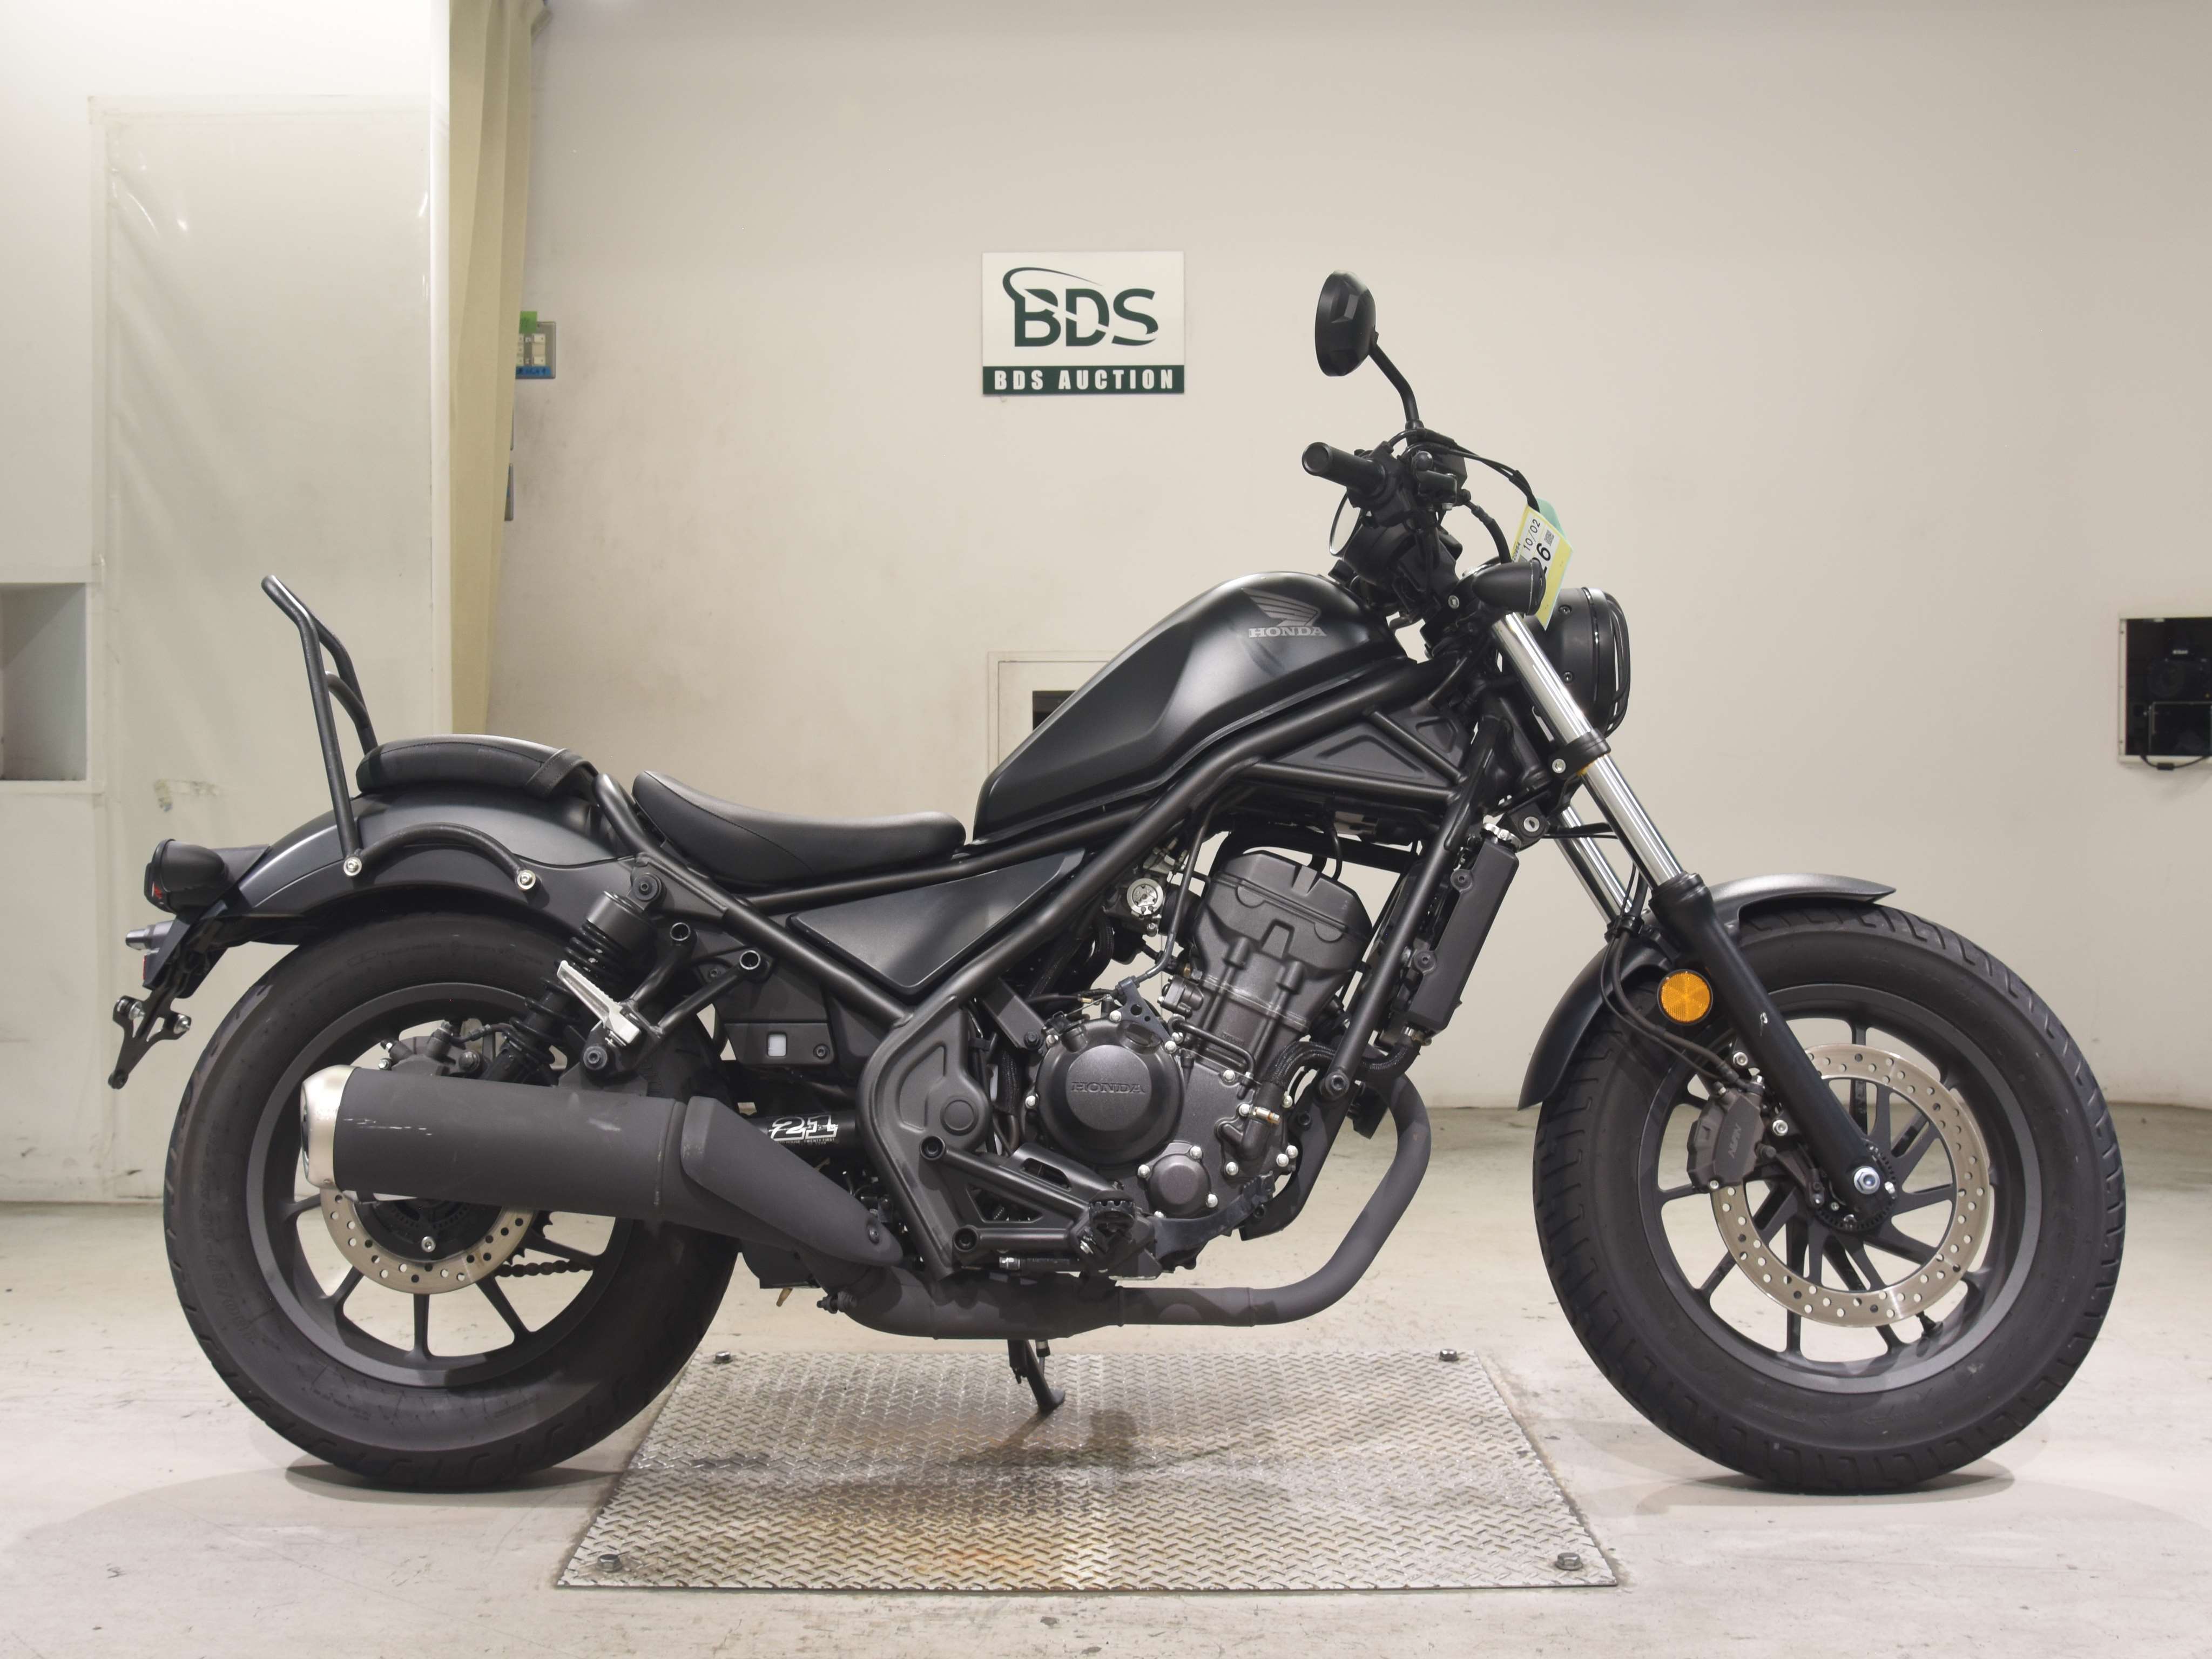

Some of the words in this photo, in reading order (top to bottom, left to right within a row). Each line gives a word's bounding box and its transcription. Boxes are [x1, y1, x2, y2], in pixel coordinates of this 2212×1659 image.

[1003, 267, 1159, 347] BDS
[994, 369, 1043, 390] BDS
[1058, 369, 1173, 389] AUCTION
[1523, 519, 1540, 551] 10/02
[1248, 626, 1327, 638] HONDA
[1071, 1082, 1145, 1094] HONDA
